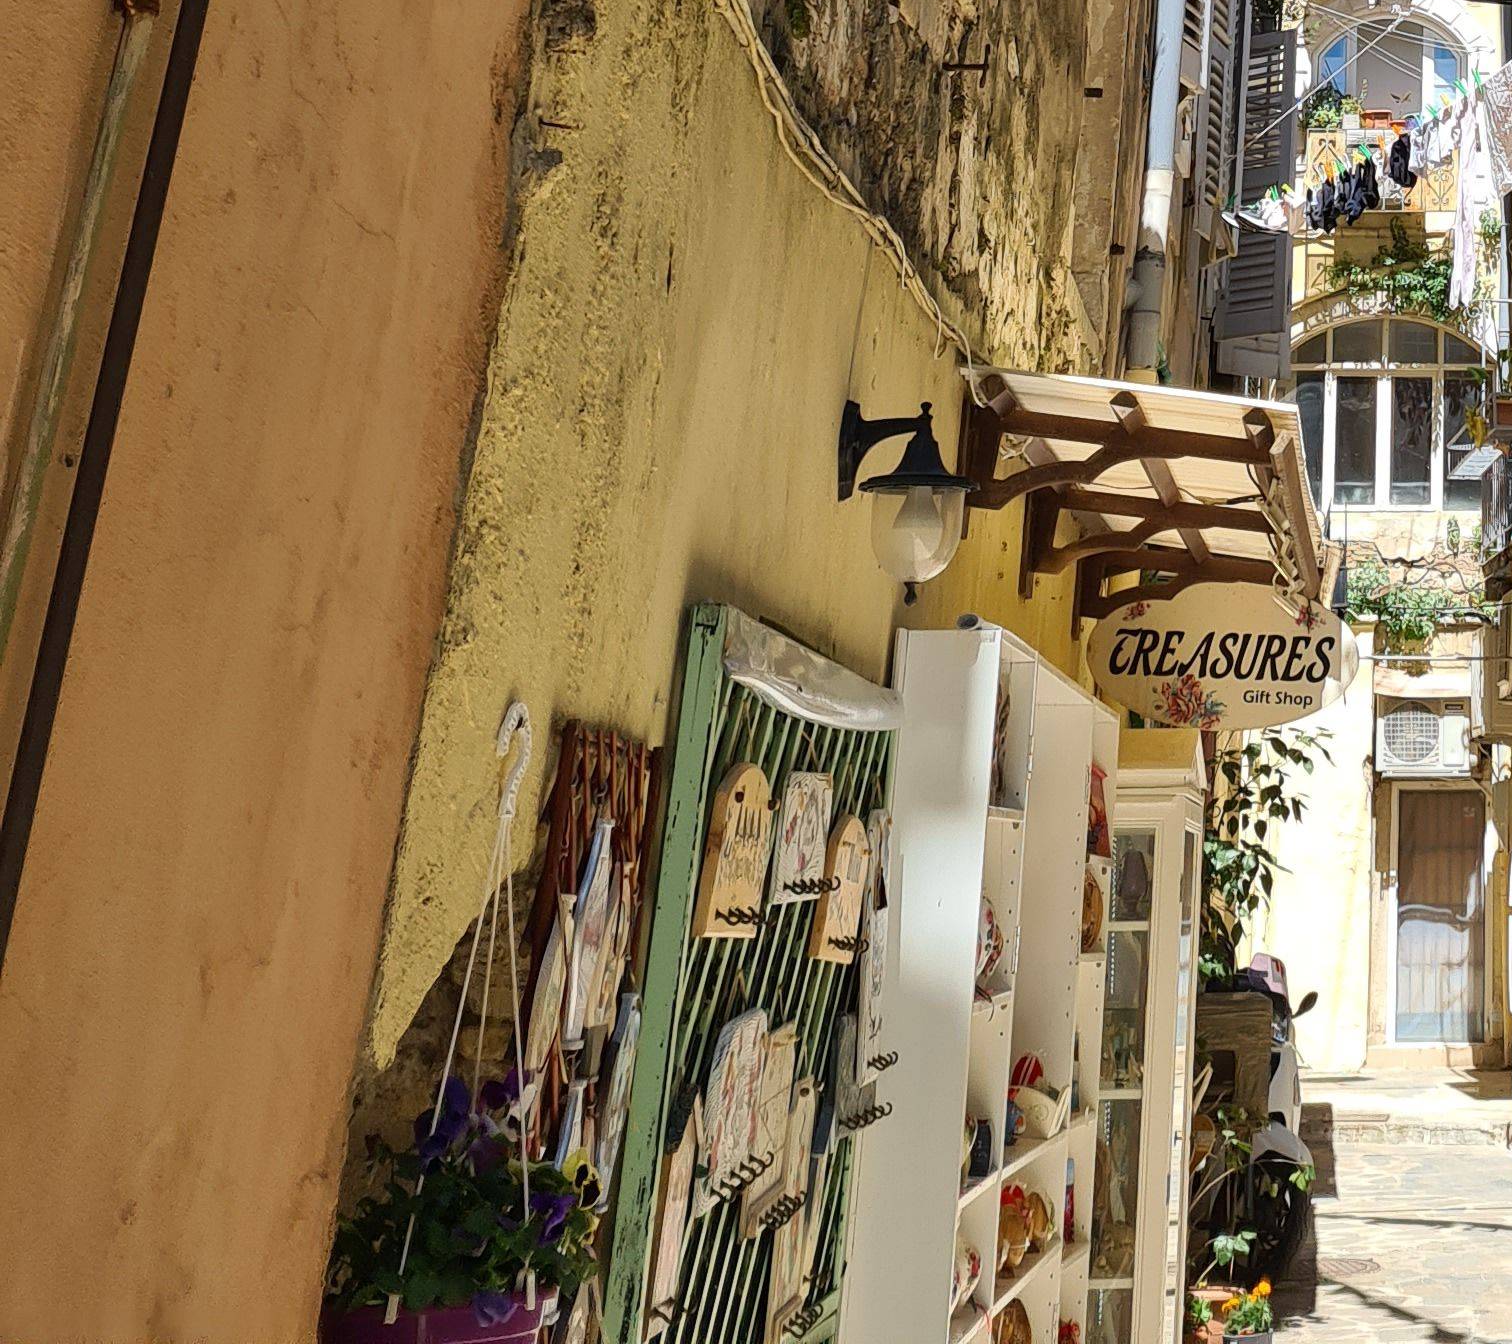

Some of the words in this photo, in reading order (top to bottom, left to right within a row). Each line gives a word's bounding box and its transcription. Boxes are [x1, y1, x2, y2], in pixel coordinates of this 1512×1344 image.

[1108, 627, 1336, 683] TREASURES
[1243, 690, 1271, 705] Gift
[1275, 691, 1313, 709] Shop
